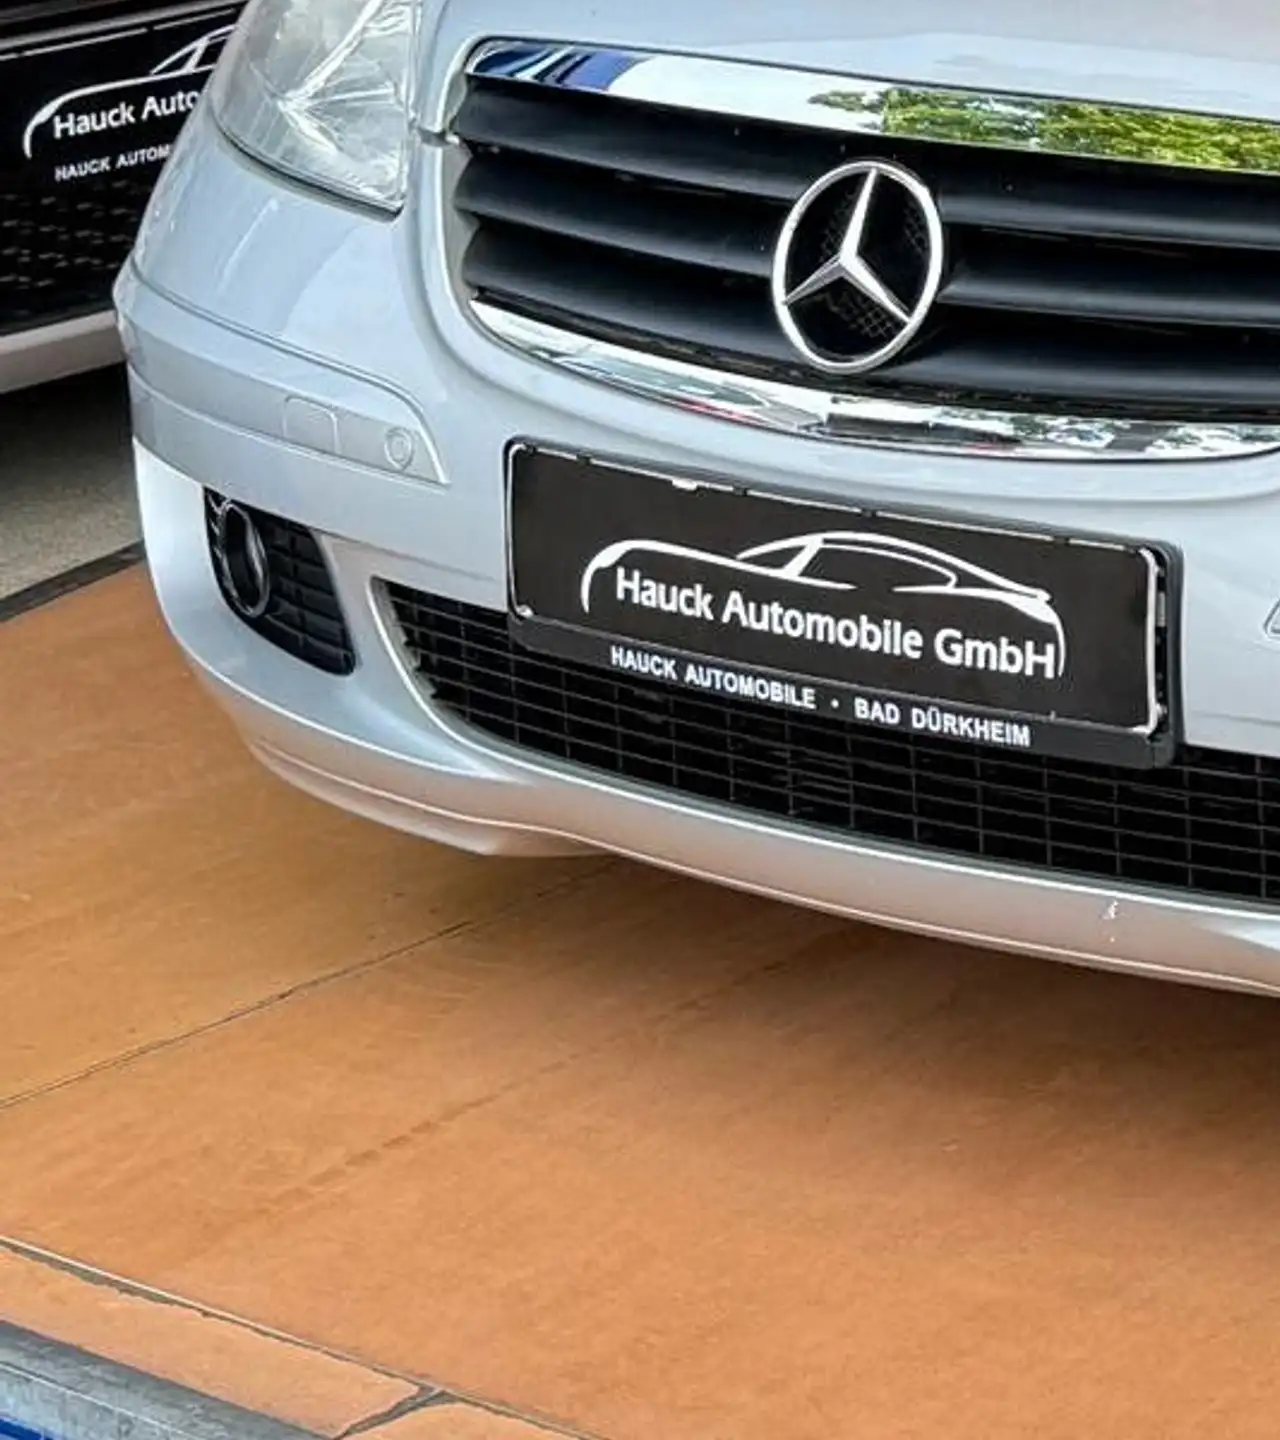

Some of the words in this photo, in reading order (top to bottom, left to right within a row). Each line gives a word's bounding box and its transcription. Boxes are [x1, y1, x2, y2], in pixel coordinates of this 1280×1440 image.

[53, 101, 136, 139] Hauck
[54, 156, 111, 182] HAUCK
[616, 566, 714, 621] Hauck
[722, 590, 923, 659] Automobile
[934, 628, 1056, 679] GmbH
[610, 645, 678, 681] HAUCK
[684, 663, 817, 709] AUTOMOBILE
[854, 697, 901, 724] BAD
[911, 706, 1031, 748] DÜRKHEIM
